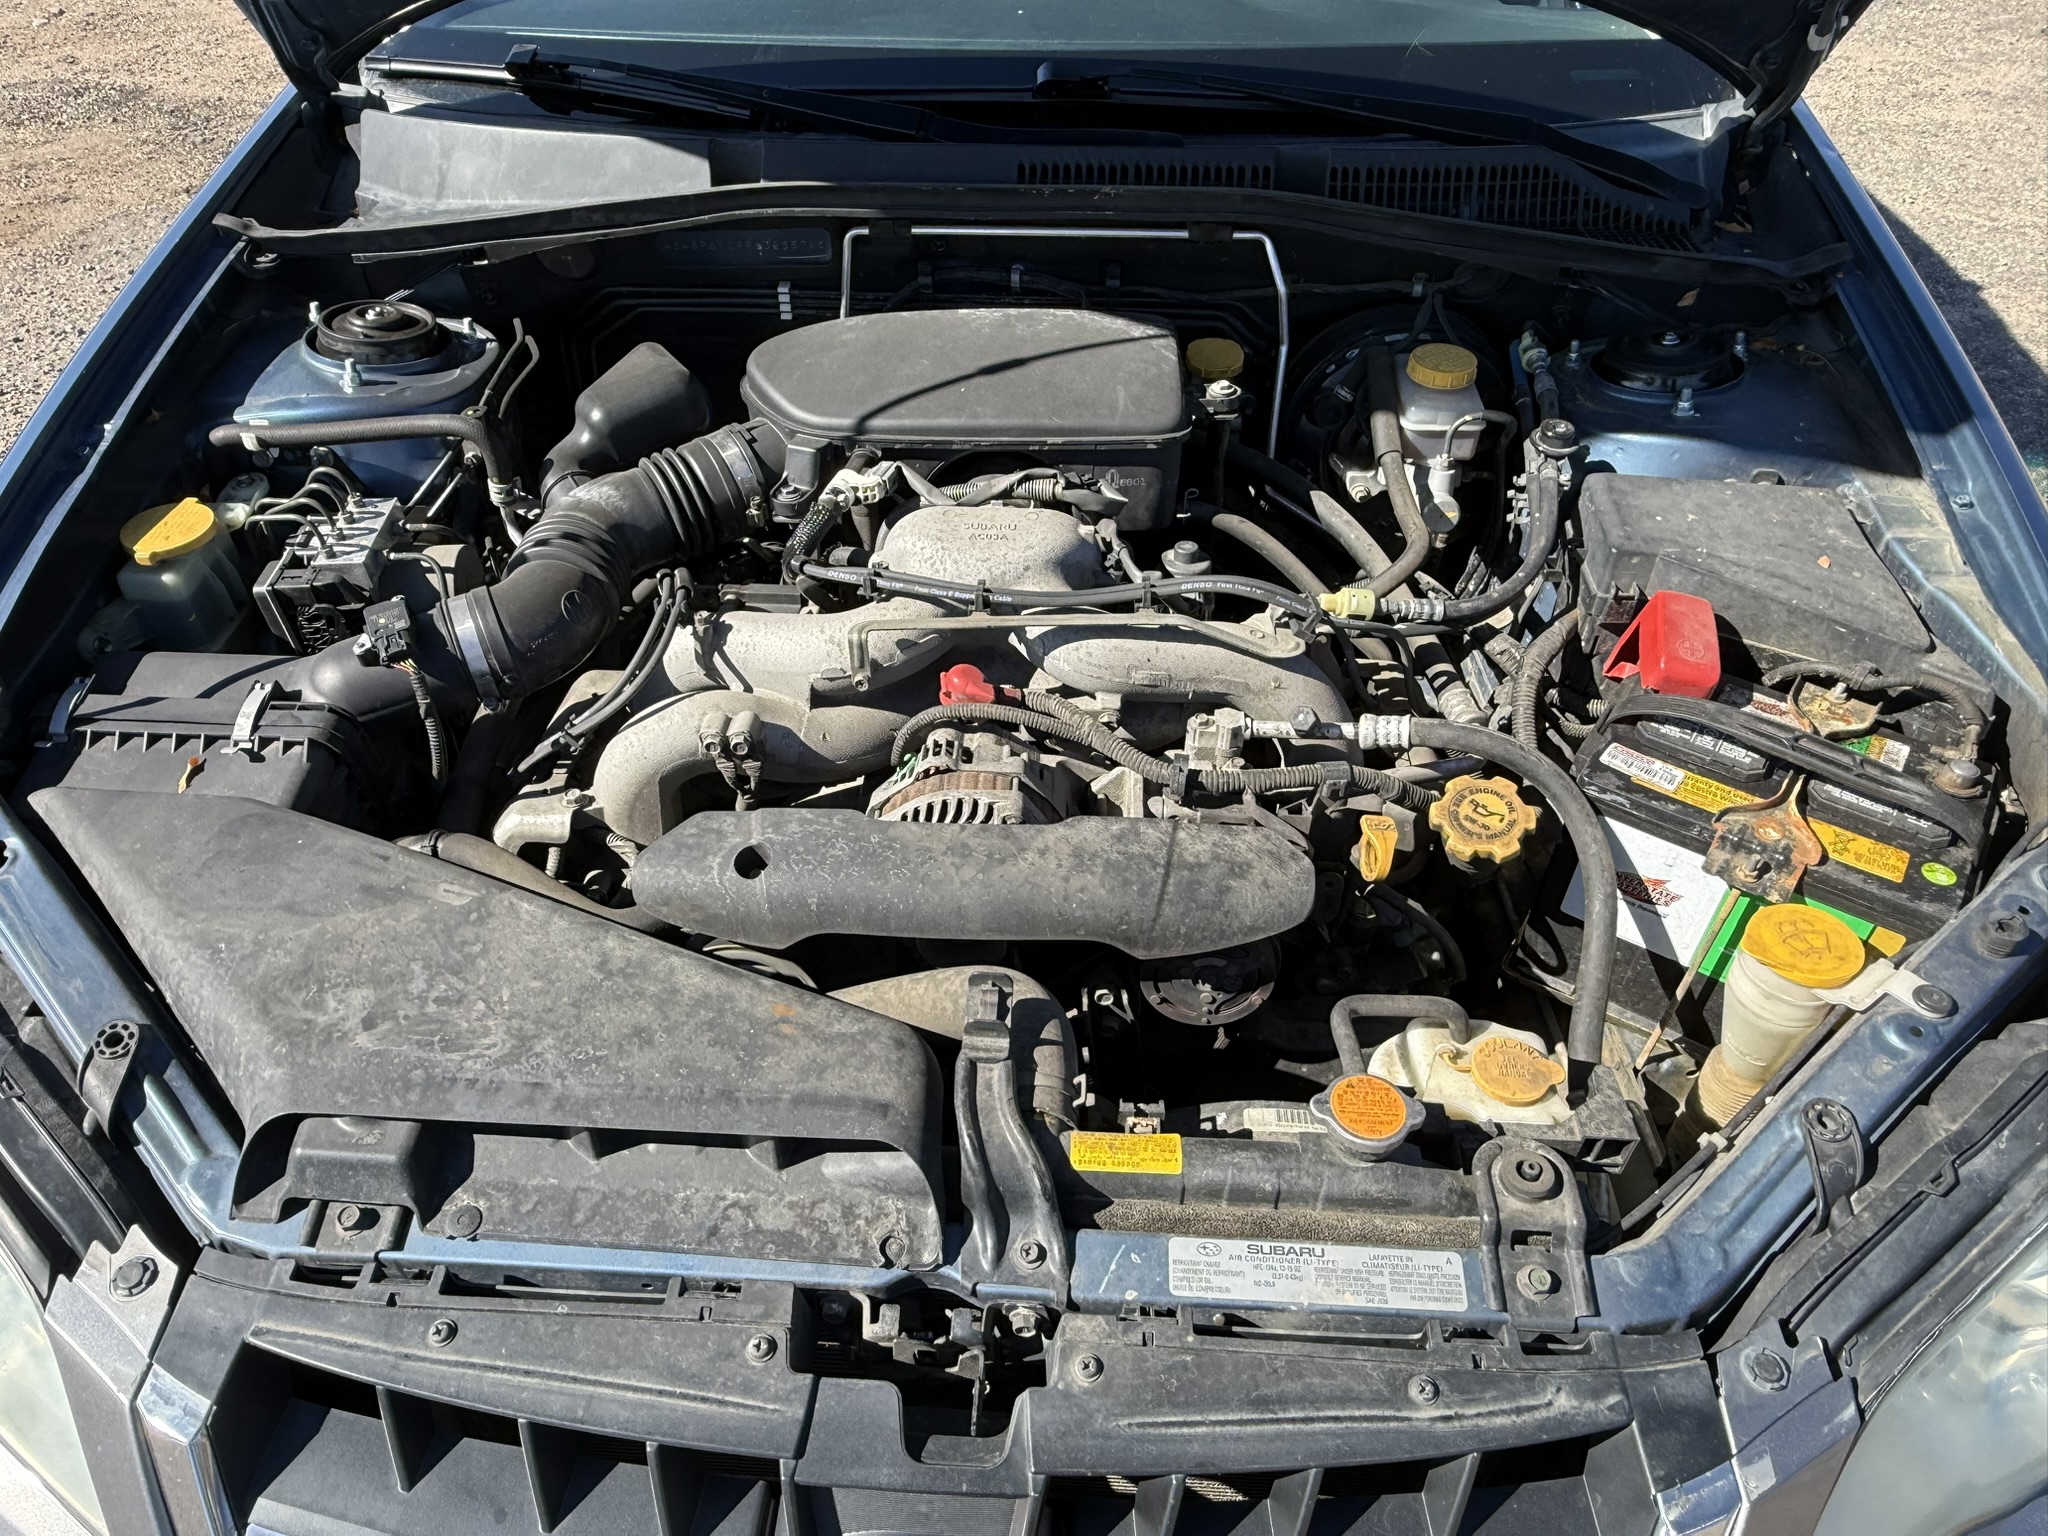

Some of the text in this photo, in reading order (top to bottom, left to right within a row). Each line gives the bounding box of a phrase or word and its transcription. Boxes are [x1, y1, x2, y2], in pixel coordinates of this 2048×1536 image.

[962, 522, 1017, 532] SUBARU
[968, 532, 1009, 541] AC03A
[827, 570, 857, 581] DENSO
[1181, 581, 1213, 590] DENSO
[1468, 787, 1508, 801] ENGINE
[1504, 800, 1517, 815] OIL
[1485, 818, 1517, 840] MANUAL
[1479, 1037, 1541, 1061] COOLANT
[1247, 1244, 1325, 1257] SUBARU
[1229, 1254, 1243, 1262] AIR
[1245, 1255, 1301, 1265] CONDITIONER
[1445, 1257, 1453, 1266] A
